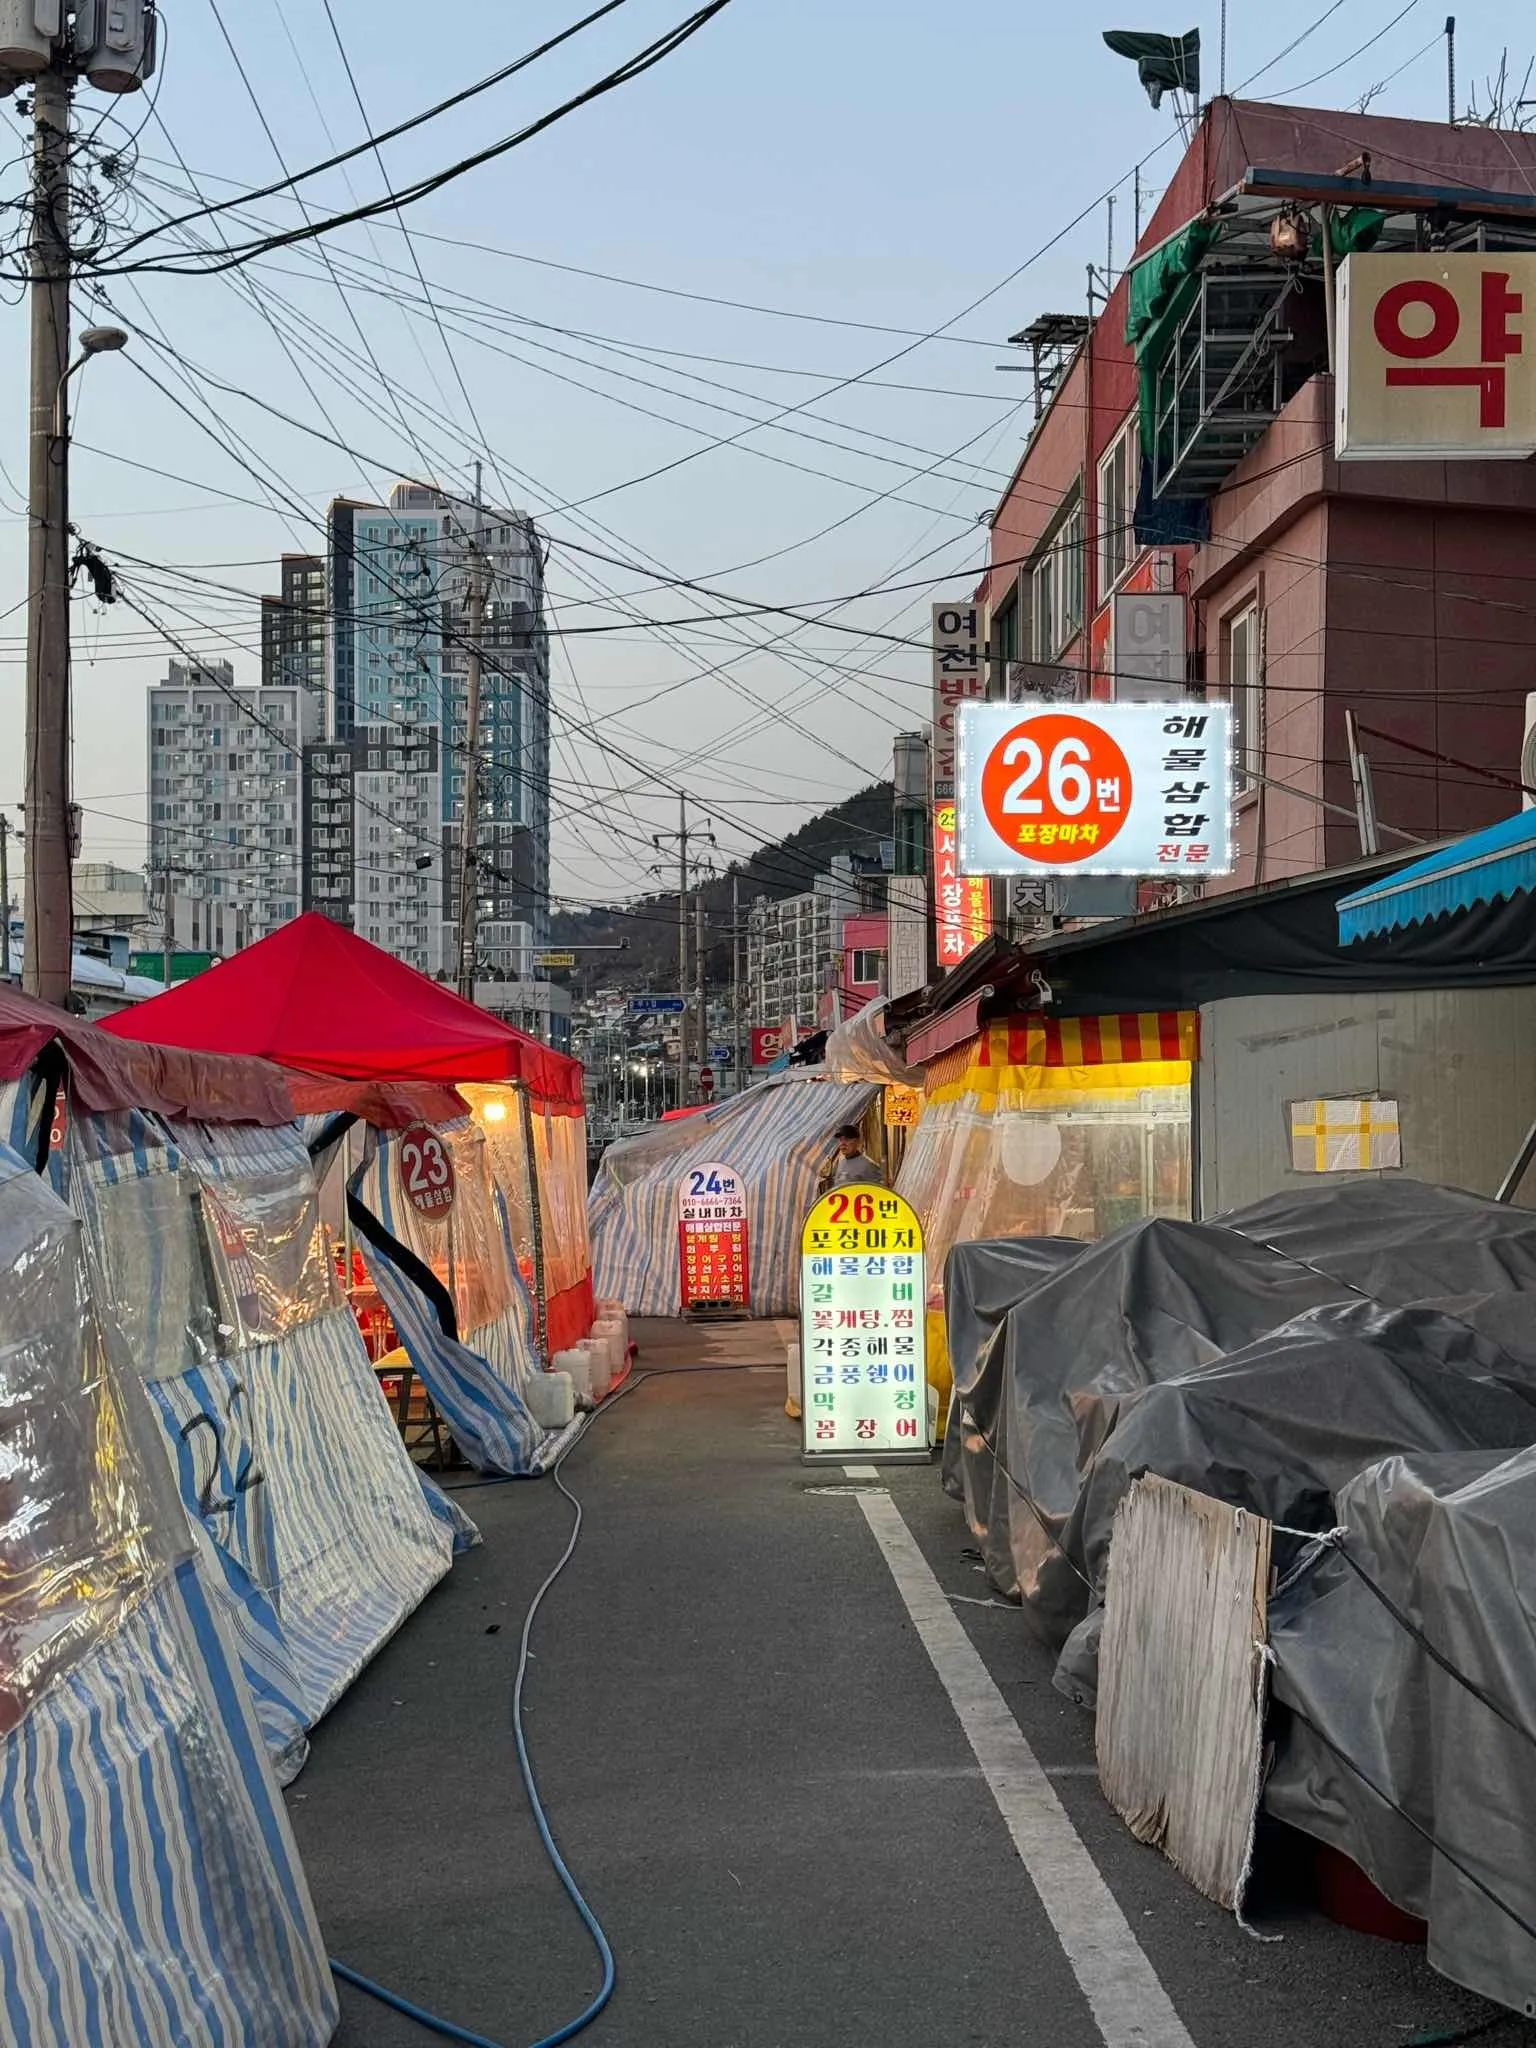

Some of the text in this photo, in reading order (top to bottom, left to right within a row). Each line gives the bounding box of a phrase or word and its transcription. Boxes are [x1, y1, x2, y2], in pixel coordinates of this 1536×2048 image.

[1373, 271, 1522, 428] 약
[1002, 737, 1120, 815] 26번
[1160, 716, 1210, 836] 해물삼합
[1017, 823, 1099, 845] 포장마차
[1156, 844, 1210, 863] 전문
[402, 1138, 449, 1192] 23
[689, 1171, 735, 1196] 24번
[683, 1206, 743, 1219] 실내마차
[828, 1193, 898, 1224] 26번
[809, 1228, 915, 1249] 포장마차
[811, 1256, 914, 1276] 해물삼합
[812, 1337, 915, 1356] 각종해물
